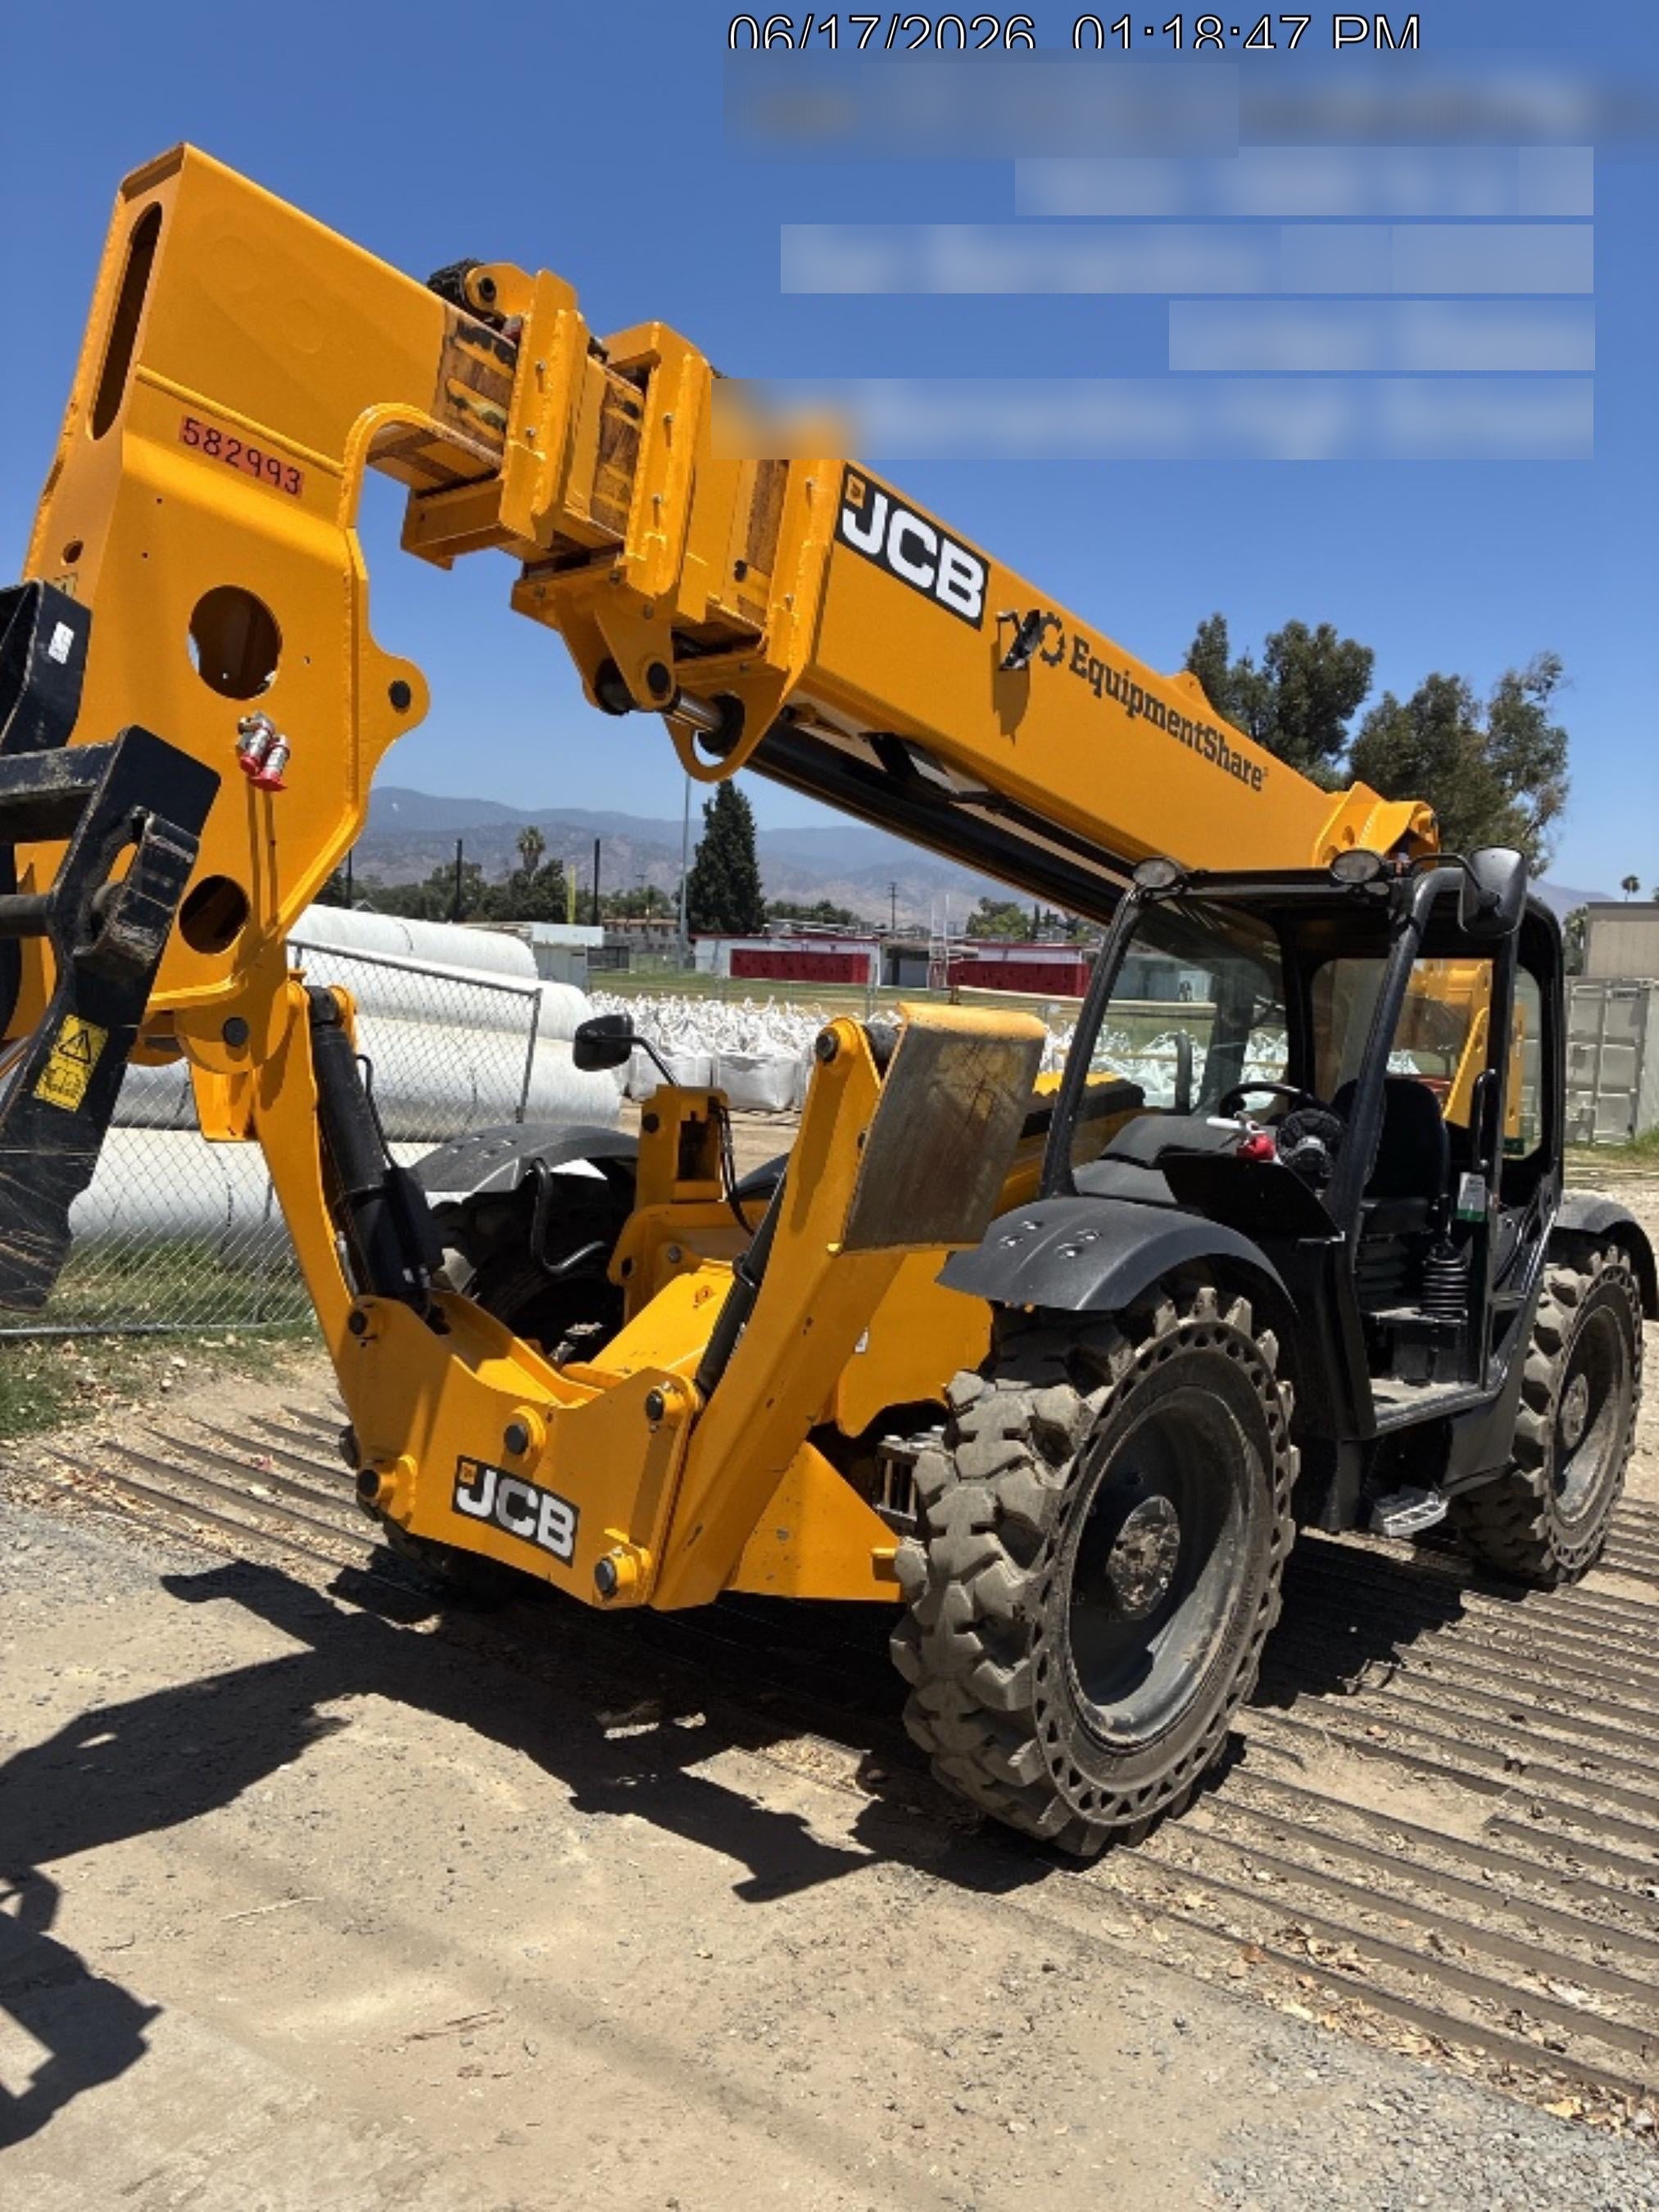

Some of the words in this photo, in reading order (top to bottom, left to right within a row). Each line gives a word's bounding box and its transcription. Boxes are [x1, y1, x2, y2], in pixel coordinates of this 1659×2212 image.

[183, 417, 301, 495] 582993
[842, 491, 985, 619] JCB
[456, 1468, 576, 1559] JCB
